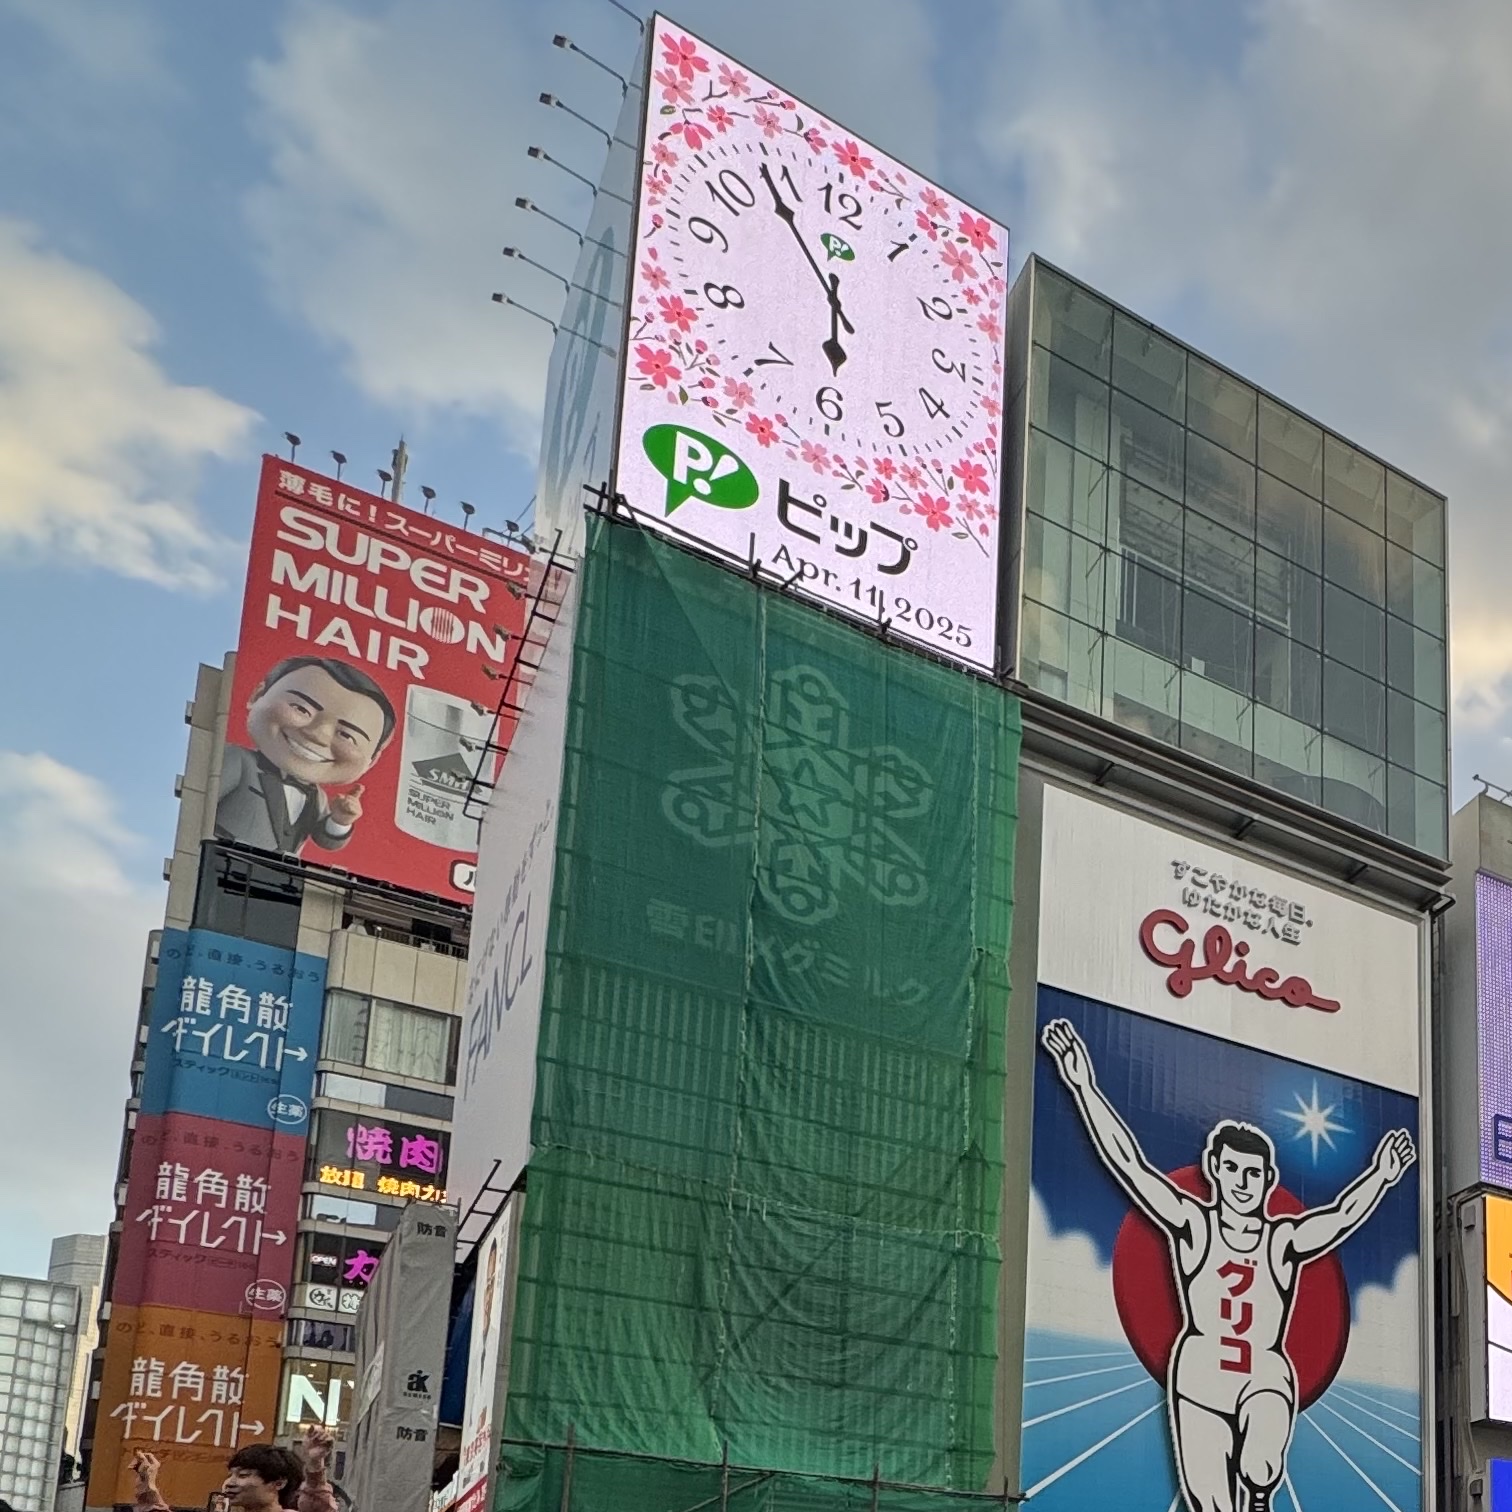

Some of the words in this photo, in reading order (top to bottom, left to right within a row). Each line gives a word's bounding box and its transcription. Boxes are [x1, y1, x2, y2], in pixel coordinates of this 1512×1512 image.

[708, 168, 756, 216] 10
[818, 183, 864, 230] 12
[687, 217, 729, 253] 9
[885, 240, 910, 262] 1
[703, 281, 745, 311] 8
[916, 295, 955, 321] 2
[754, 341, 794, 367] 7
[932, 348, 966, 383] 3
[815, 387, 843, 421] 6
[876, 400, 905, 437] 5
[918, 388, 947, 420] 4
[776, 477, 918, 575] ピップ
[277, 506, 490, 614] SUPER
[271, 549, 506, 663] MILLION
[771, 543, 841, 592] Apr.
[895, 597, 972, 648] 2025
[265, 594, 429, 679] HAIR
[406, 807, 436, 825] HAIR
[408, 788, 450, 810] SUPER
[181, 975, 293, 1032] 龍角散
[347, 1124, 443, 1174] 焼肉
[156, 1162, 272, 1214] 龍角散
[417, 1222, 446, 1237] 防音
[312, 1255, 337, 1266] OPEN
[1216, 1258, 1257, 1374] グリコ
[130, 1357, 249, 1405] 龍角散
[397, 1427, 428, 1442] 防音
